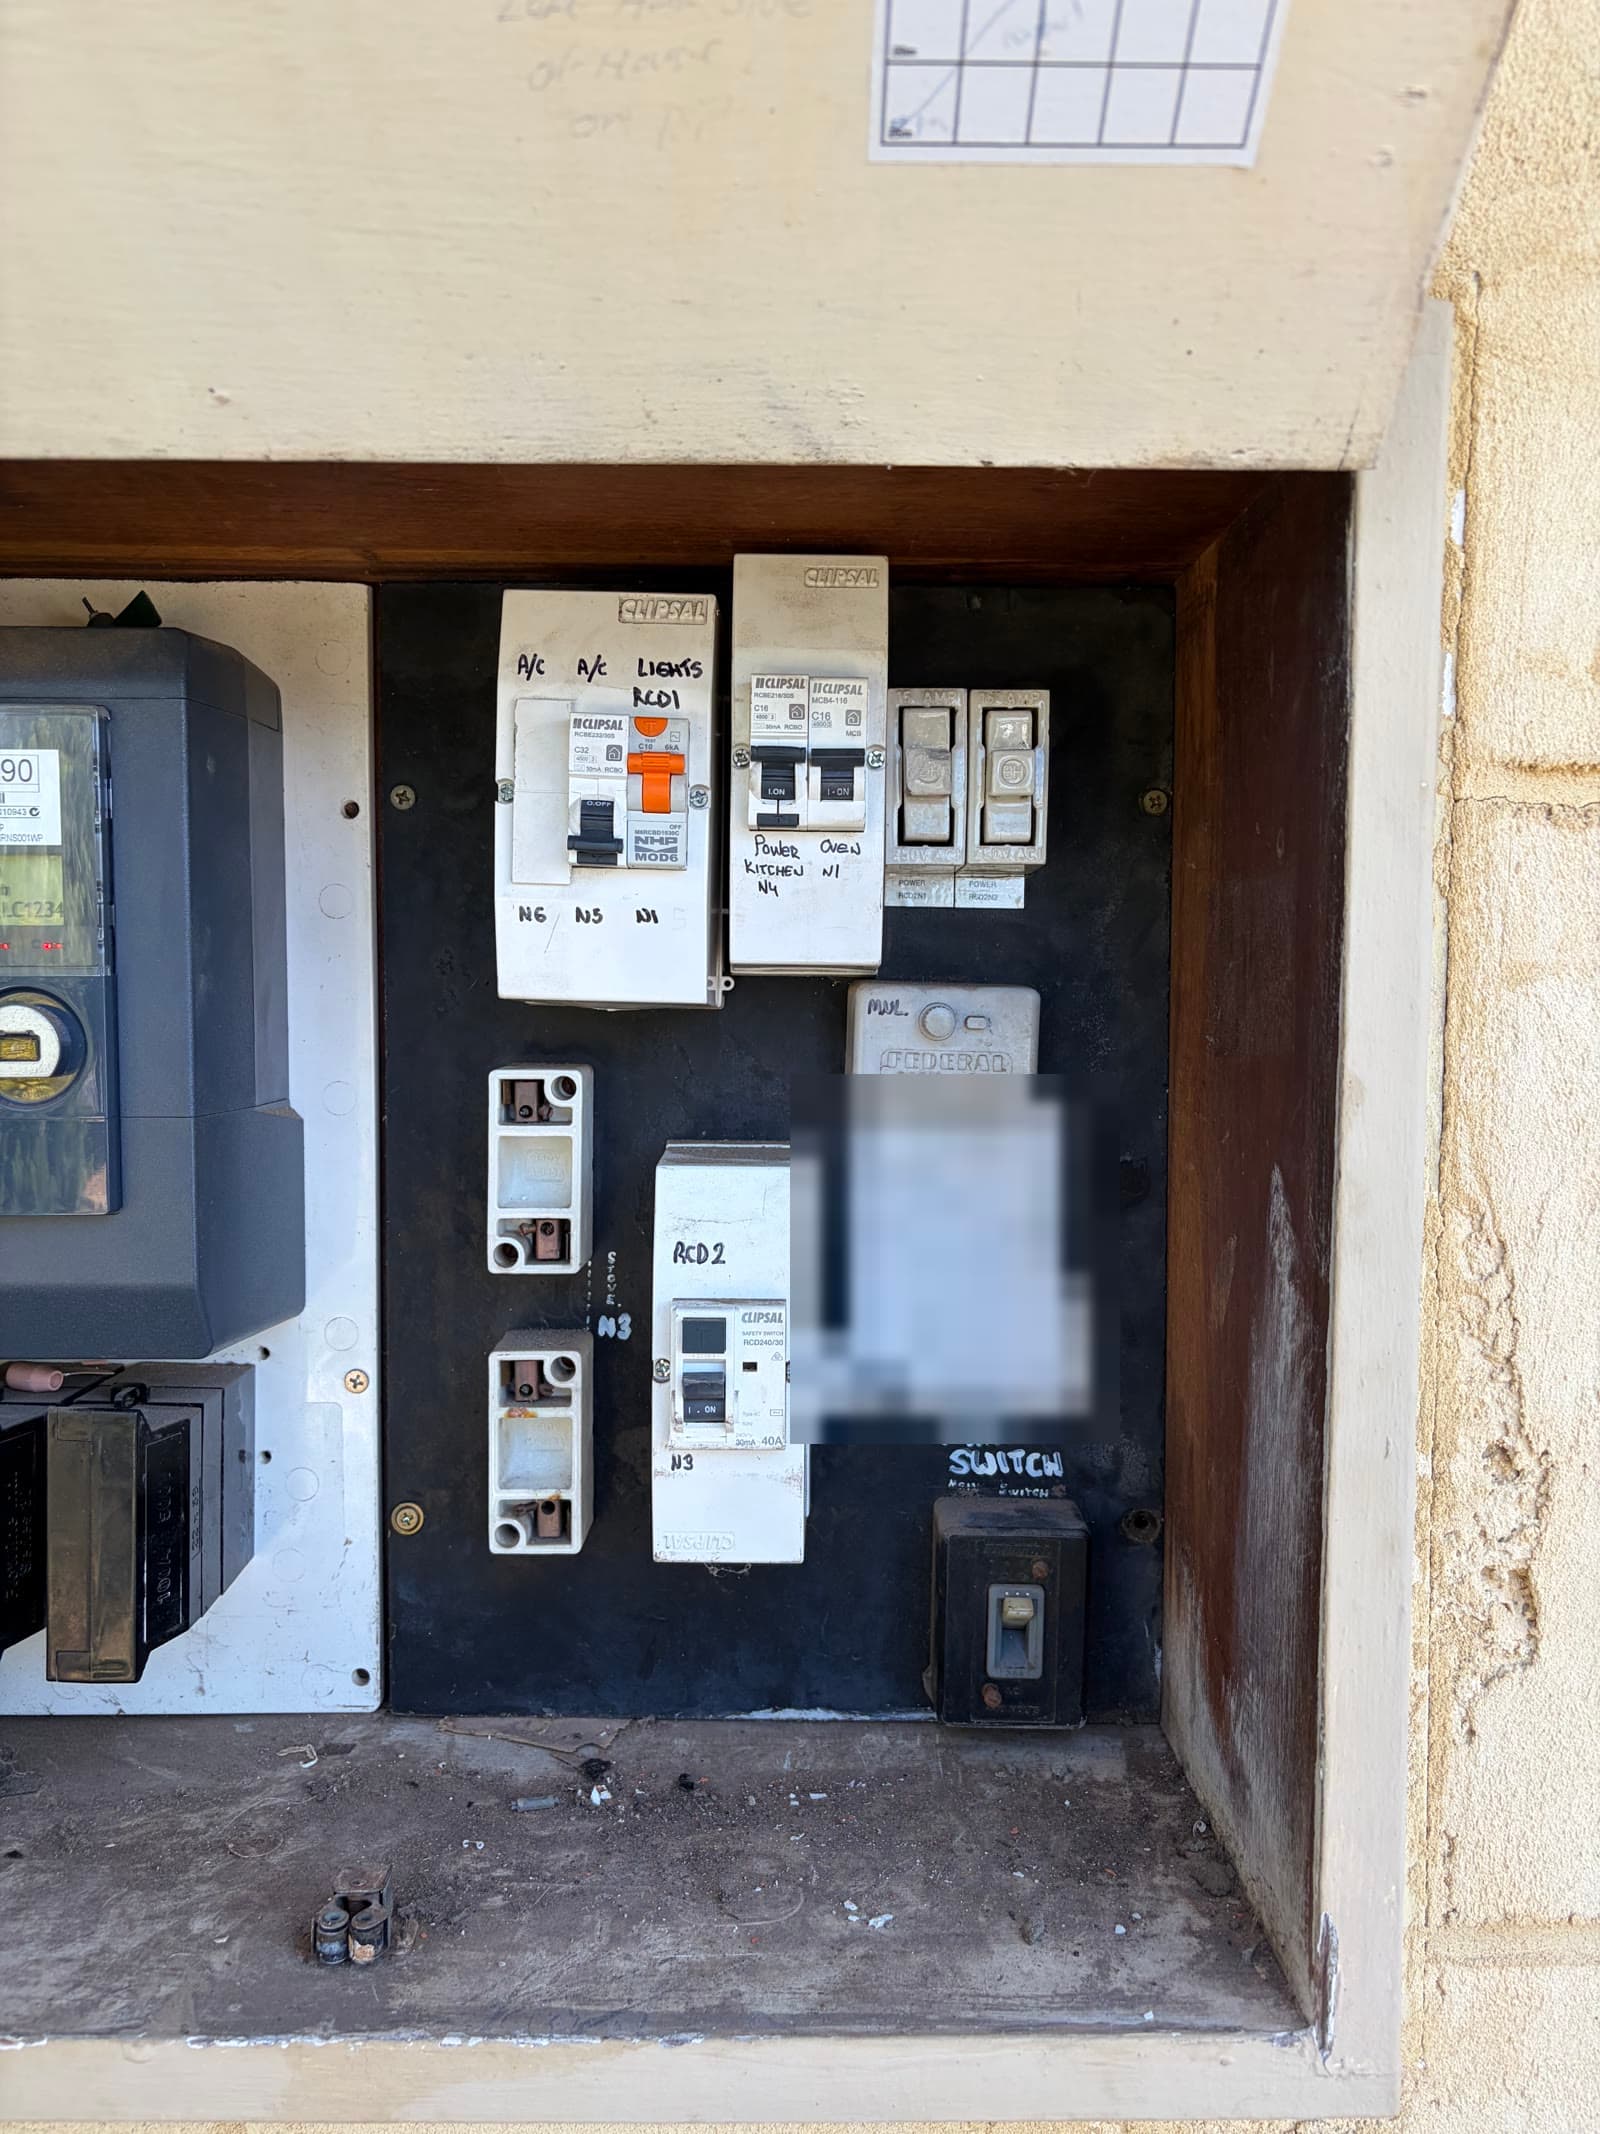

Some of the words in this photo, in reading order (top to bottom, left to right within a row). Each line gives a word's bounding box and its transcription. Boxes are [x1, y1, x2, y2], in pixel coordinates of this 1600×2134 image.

[805, 568, 879, 588] CLIPSAL
[620, 599, 707, 621] CLIPSAL
[518, 653, 545, 681] A/C
[577, 654, 608, 683] A/C
[637, 658, 703, 679] LIGHTS
[766, 678, 806, 689] CLIPSAL
[823, 683, 863, 695] CLIPSAL
[633, 687, 680, 709] RCD1
[583, 718, 623, 731] CLIPSAL
[811, 711, 831, 721] C16
[634, 836, 679, 846] NHP
[635, 852, 679, 862] MOD6
[744, 859, 804, 877] KITCHEN
[758, 880, 779, 897] N4
[898, 879, 926, 887] POWER
[519, 906, 547, 923] N6
[576, 906, 604, 924] N5
[887, 1051, 1008, 1073] FEDERAL
[598, 1312, 633, 1340] N3
[741, 1312, 783, 1323] CLIPSAL
[704, 1405, 717, 1414] ON
[762, 1436, 784, 1446] 40A
[670, 1454, 694, 1471] N3
[949, 1448, 1064, 1479] SWITCH
